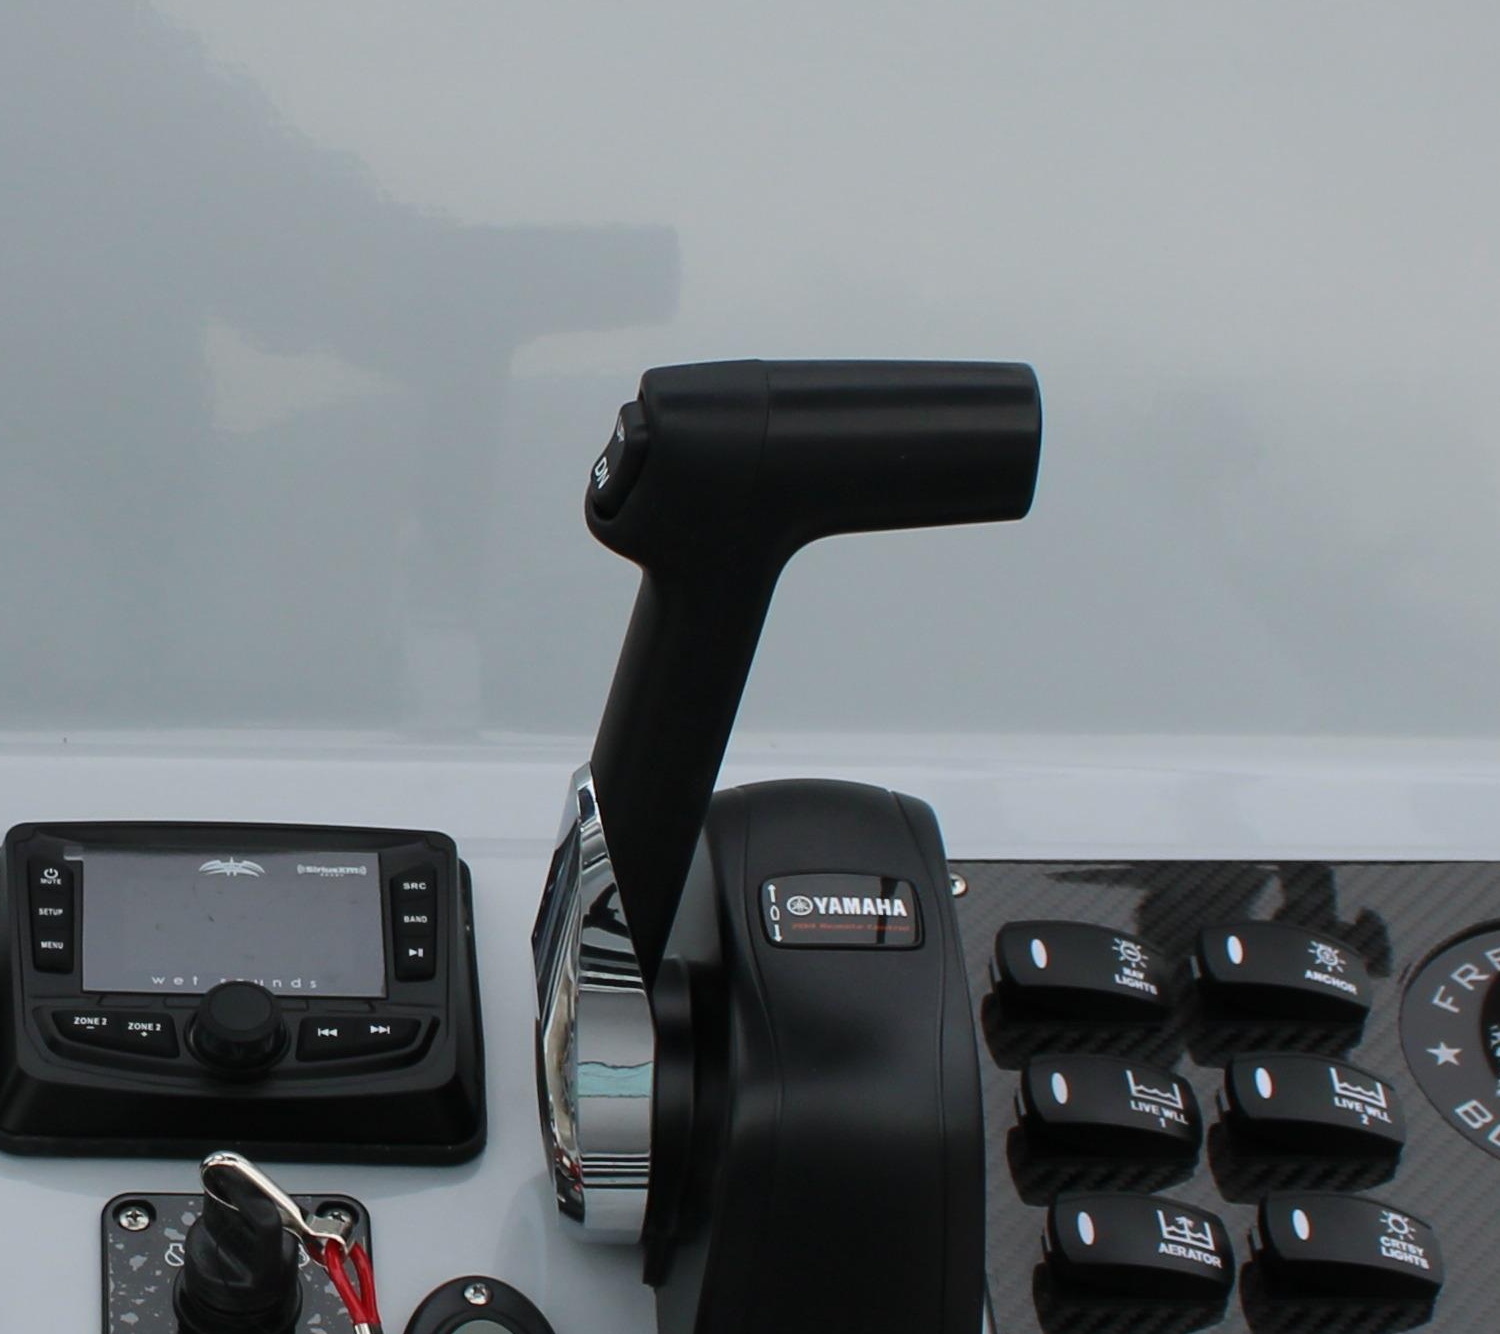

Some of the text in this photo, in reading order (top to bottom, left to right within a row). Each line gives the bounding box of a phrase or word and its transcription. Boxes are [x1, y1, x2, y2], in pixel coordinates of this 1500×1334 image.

[402, 882, 427, 890] SRC
[39, 908, 63, 916] SETUP
[813, 896, 908, 917] YAMAHA
[403, 915, 428, 924] BAND
[40, 941, 64, 949] MENU
[219, 978, 318, 988] sunds
[1114, 973, 1158, 996] LIGHTS
[1305, 970, 1358, 996] ANCHOR
[73, 1017, 100, 1025] ZONE
[128, 1022, 154, 1031] ZONE
[1130, 1100, 1189, 1125] LIVE WLL
[1334, 1096, 1393, 1124] LIVE WLL
[1158, 1242, 1222, 1269] AERATOR
[1381, 1246, 1430, 1269] LIGHTS
